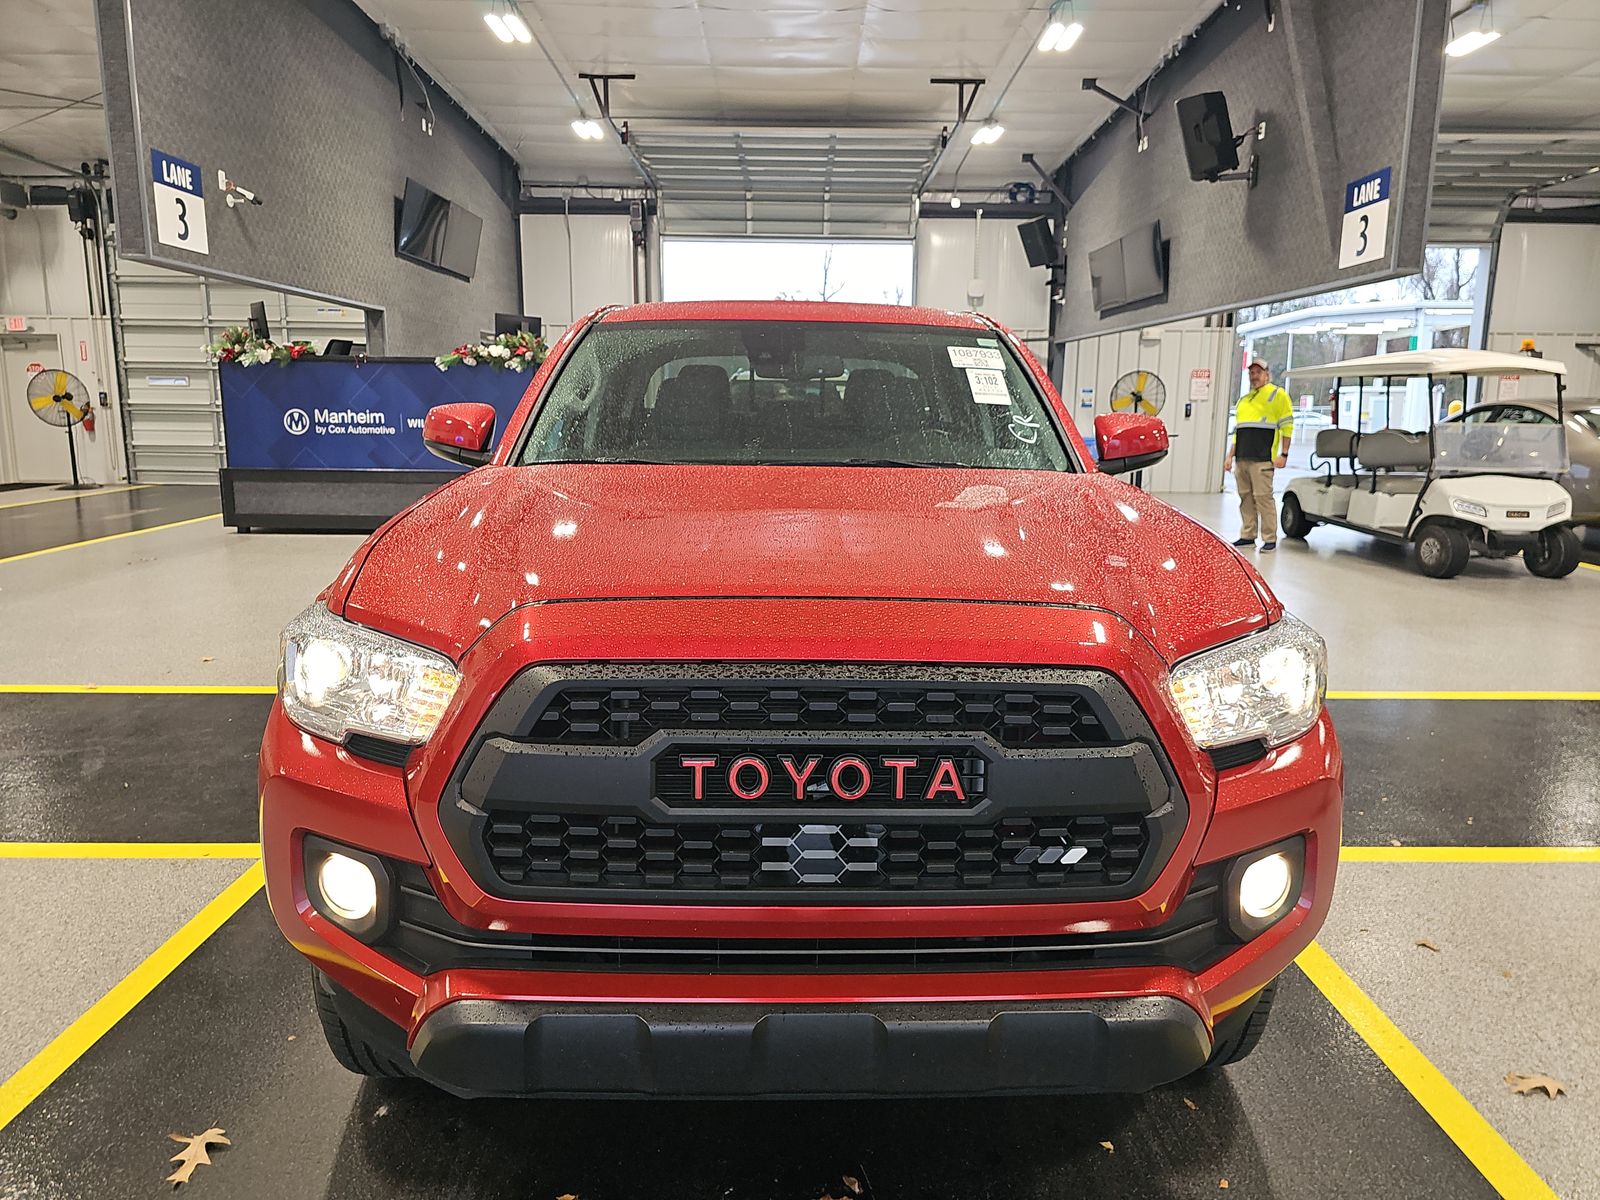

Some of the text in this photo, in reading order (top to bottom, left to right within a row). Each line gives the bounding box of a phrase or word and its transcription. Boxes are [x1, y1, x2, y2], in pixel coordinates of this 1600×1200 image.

[162, 160, 194, 191] LANE
[1352, 177, 1382, 208] LANE
[175, 197, 190, 241] 3
[1356, 214, 1369, 257] 3
[314, 408, 385, 424] Manheim
[315, 425, 396, 436] by Cox Automotive
[680, 754, 969, 801] TOYOTA
